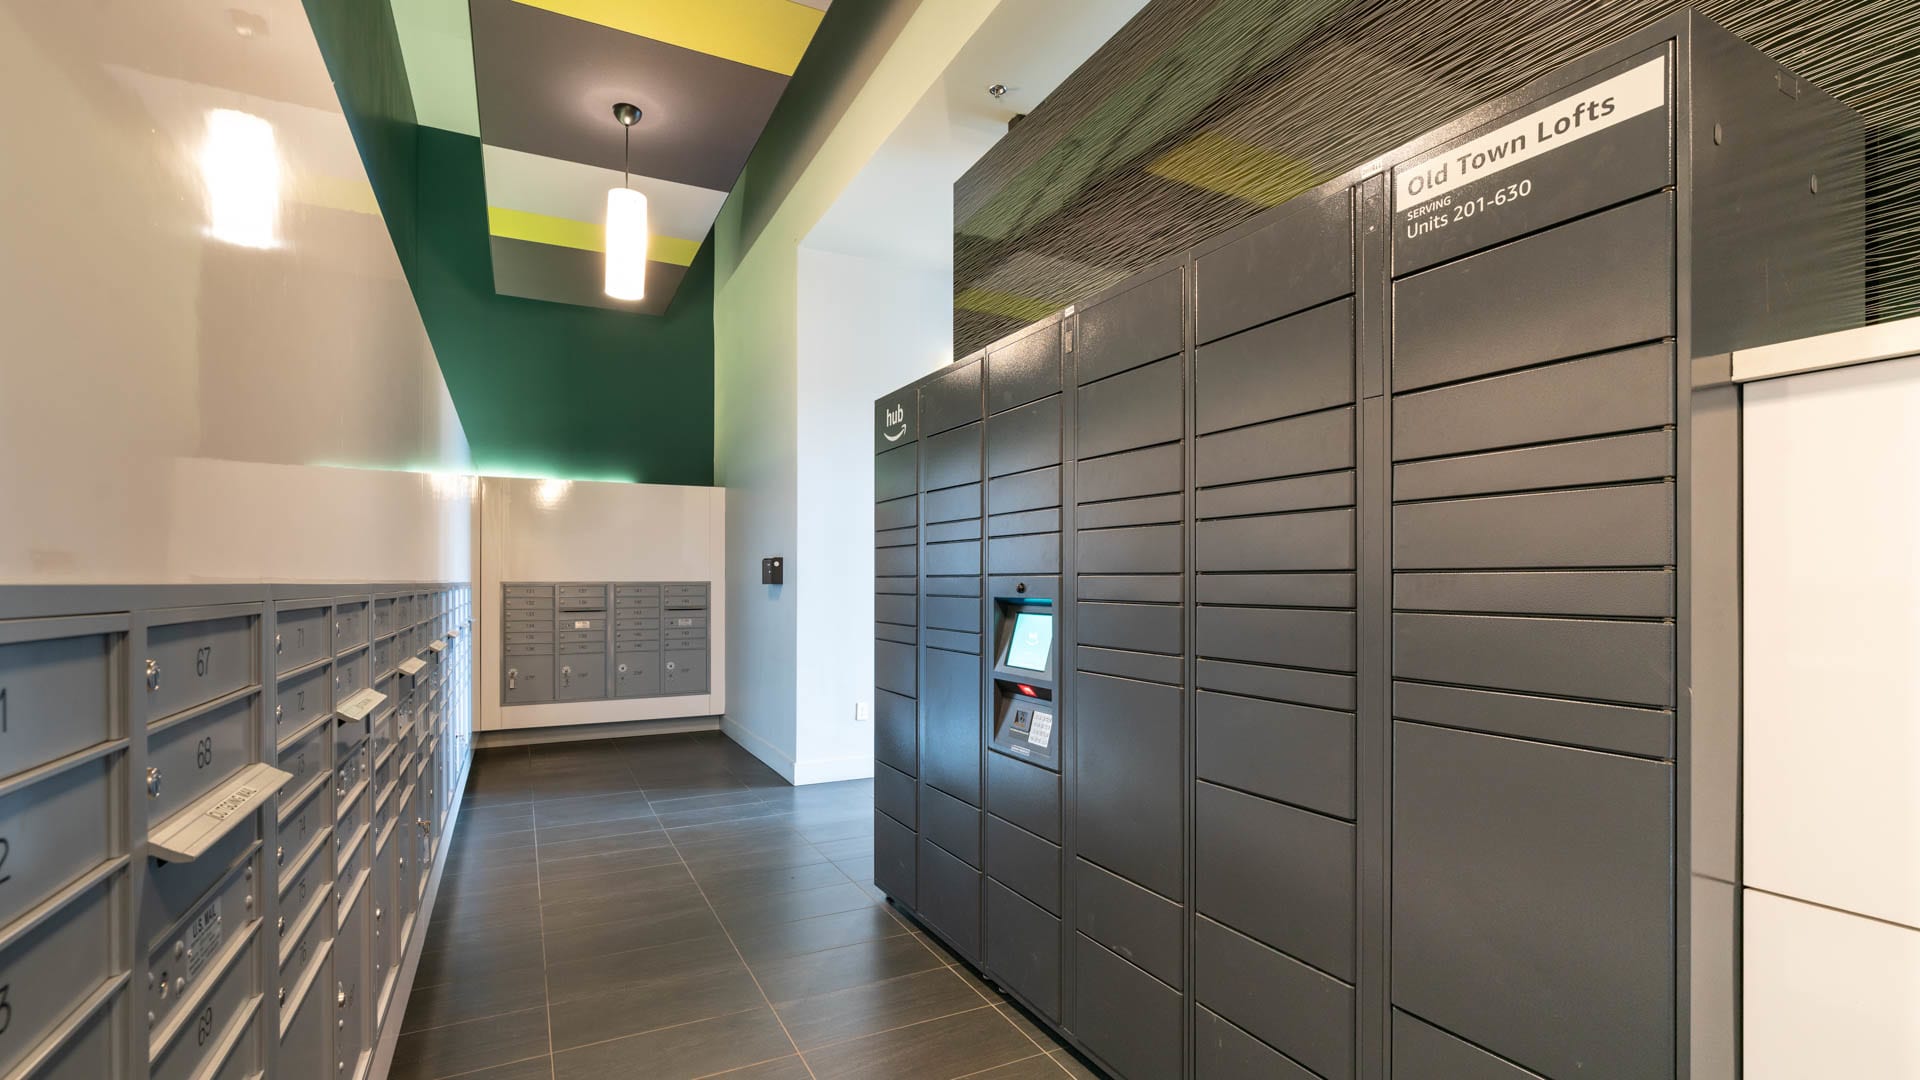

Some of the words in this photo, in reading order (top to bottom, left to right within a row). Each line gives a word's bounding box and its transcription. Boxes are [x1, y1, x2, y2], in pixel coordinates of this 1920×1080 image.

[1408, 162, 1448, 196] Old
[1457, 134, 1526, 176] Town
[1537, 96, 1616, 144] Lofts
[1407, 195, 1452, 221] SERVING
[1407, 214, 1449, 239] Units
[1452, 179, 1532, 223] 201-630
[886, 403, 904, 428] hub
[196, 646, 211, 677] 67
[197, 736, 212, 769] 68
[198, 1007, 212, 1047] 69
